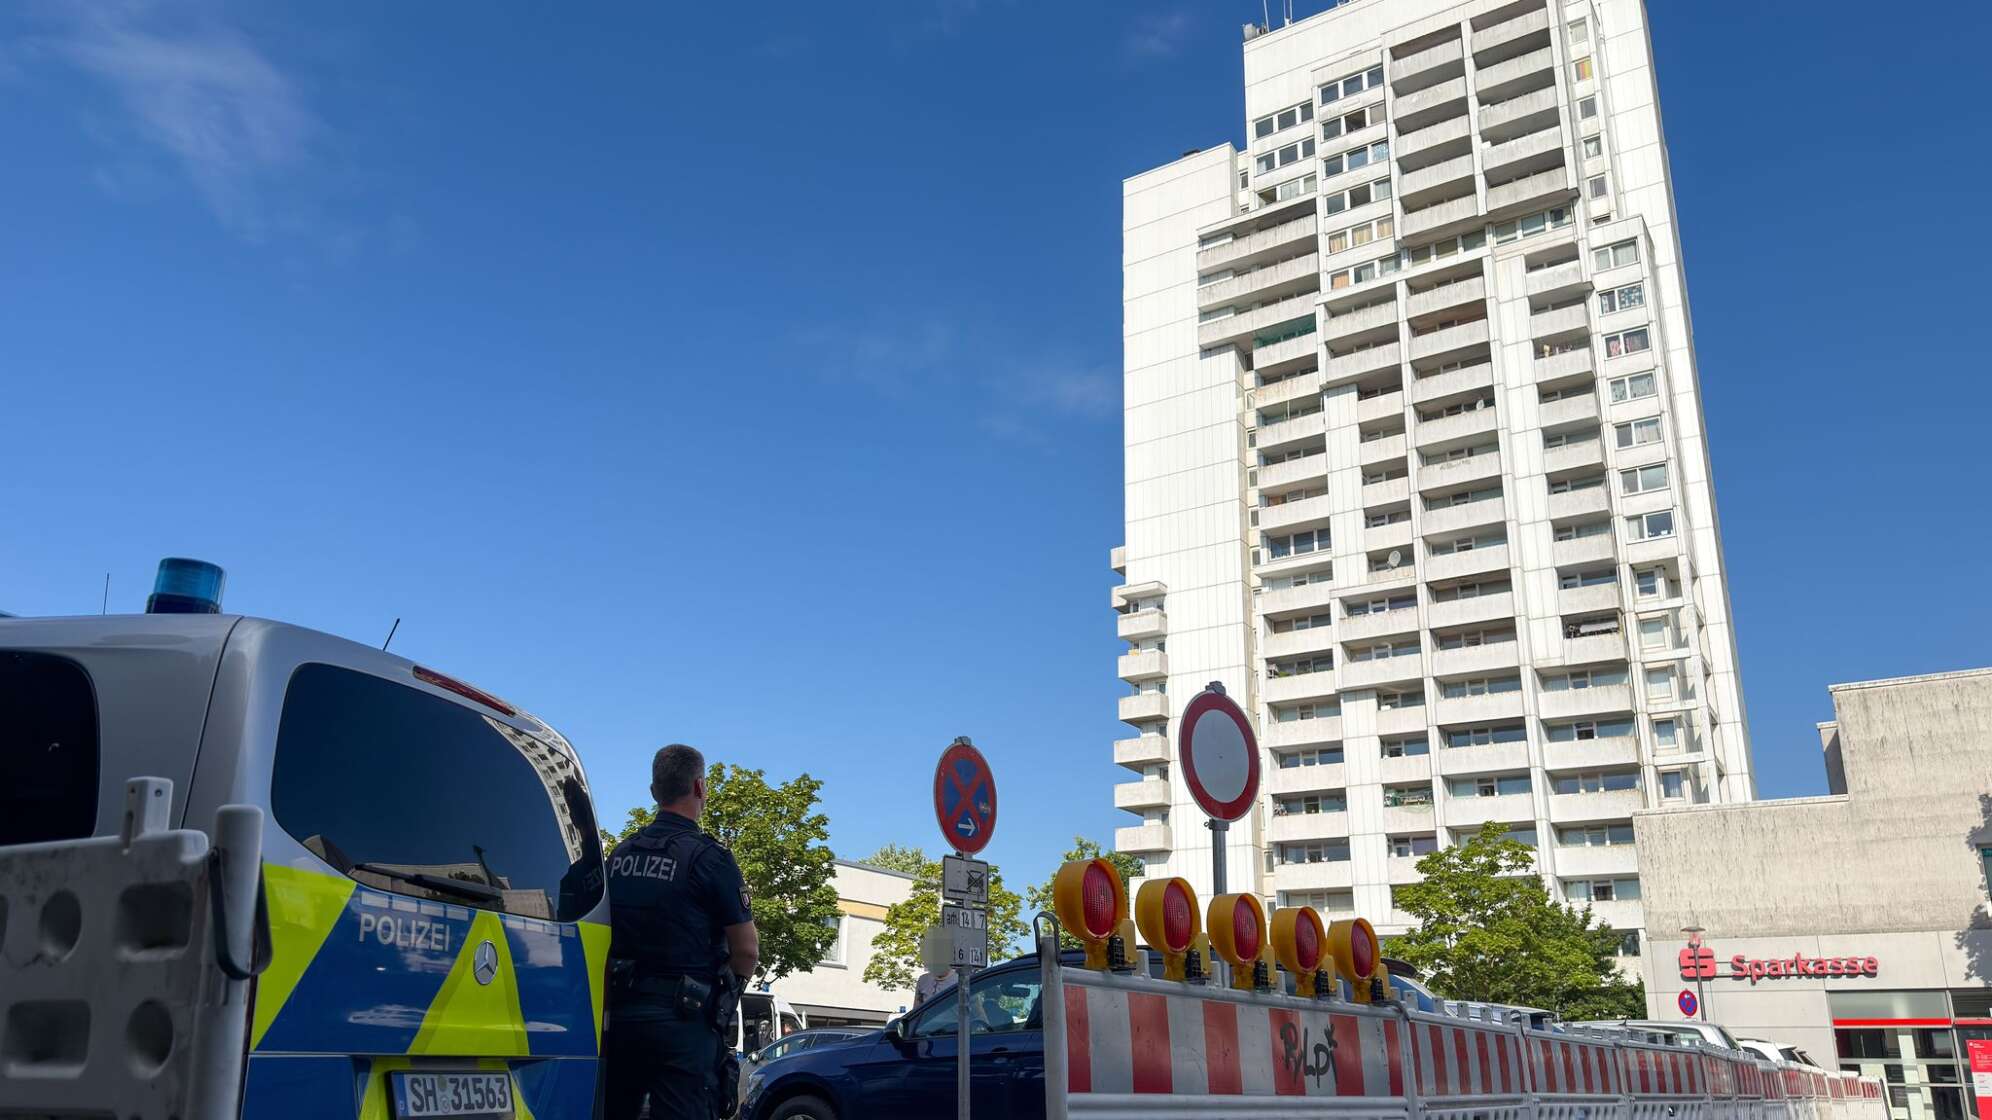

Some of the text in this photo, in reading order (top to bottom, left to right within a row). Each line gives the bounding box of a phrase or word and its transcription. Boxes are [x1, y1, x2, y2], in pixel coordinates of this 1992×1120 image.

[610, 855, 677, 881] POLIZEI
[359, 912, 450, 952] POLIZEI
[978, 914, 985, 928] 7
[1731, 952, 1879, 986] Sparkasse
[410, 1078, 439, 1112] SH
[447, 1077, 508, 1111] 31563
